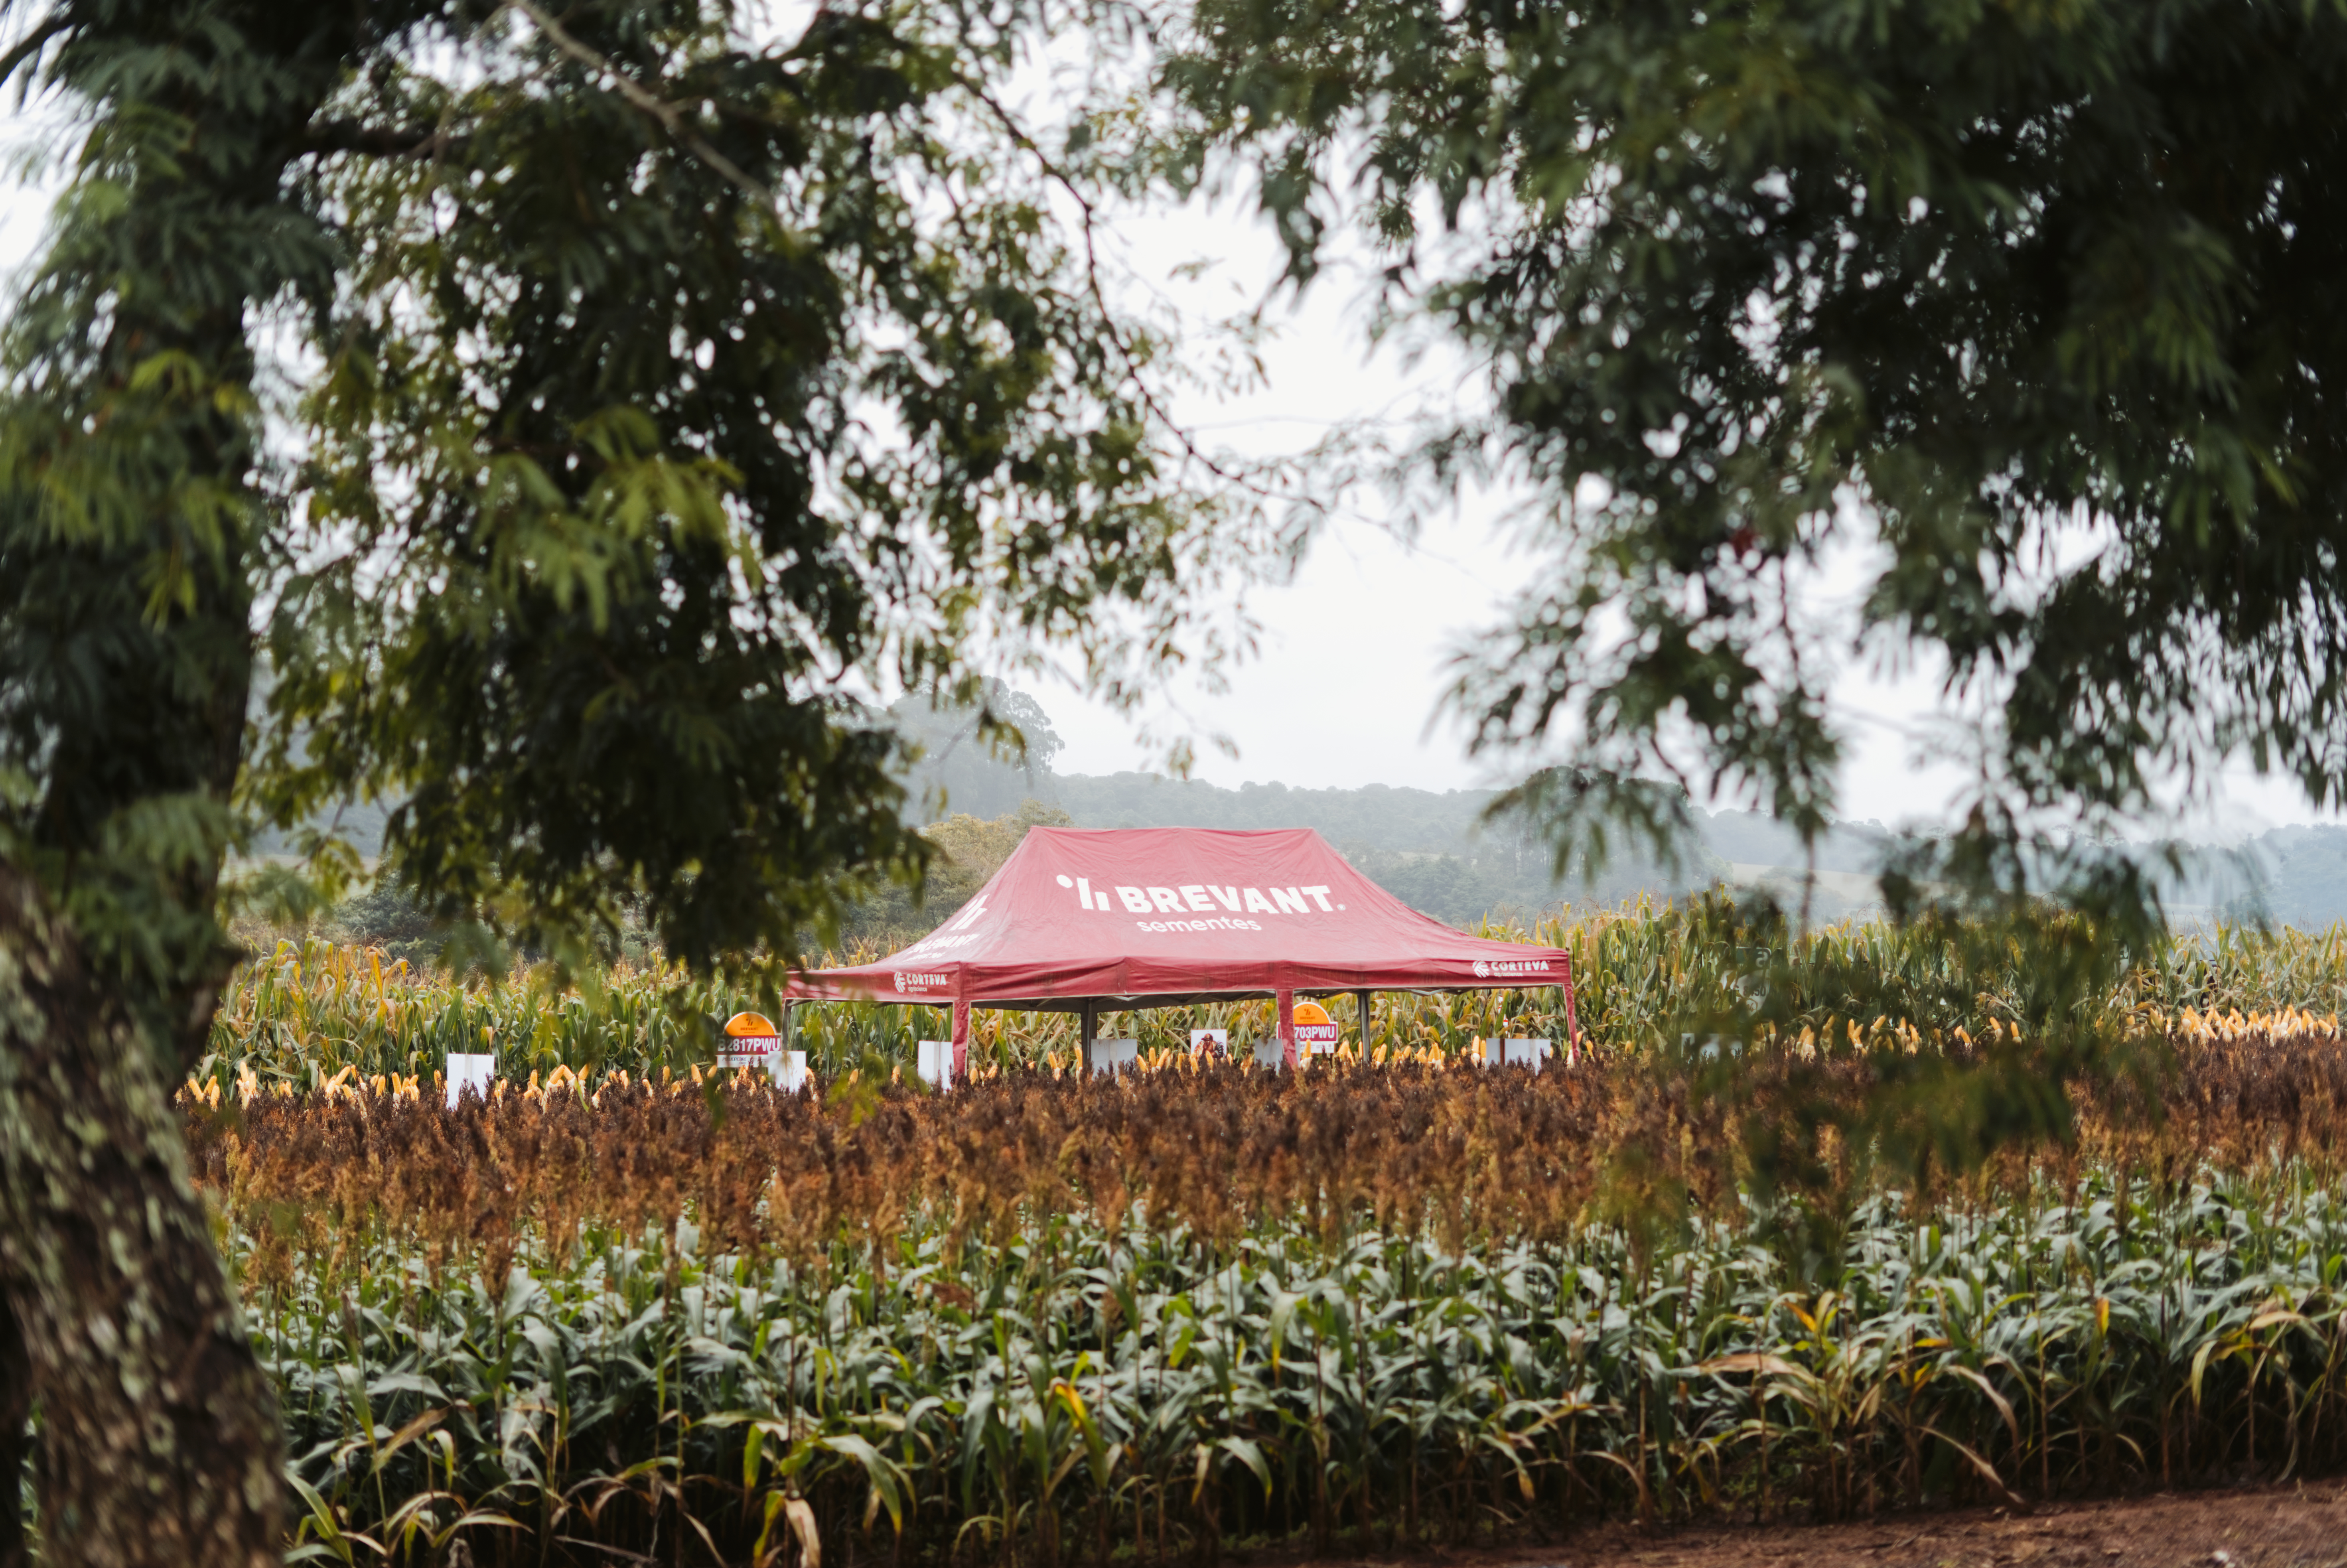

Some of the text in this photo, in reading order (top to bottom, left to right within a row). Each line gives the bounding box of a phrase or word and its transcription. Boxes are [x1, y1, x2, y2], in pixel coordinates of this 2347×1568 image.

[1137, 916, 1262, 932] sementes
[1294, 1026, 1335, 1039] 703PWU
[718, 1038, 781, 1051] B2817PWU
